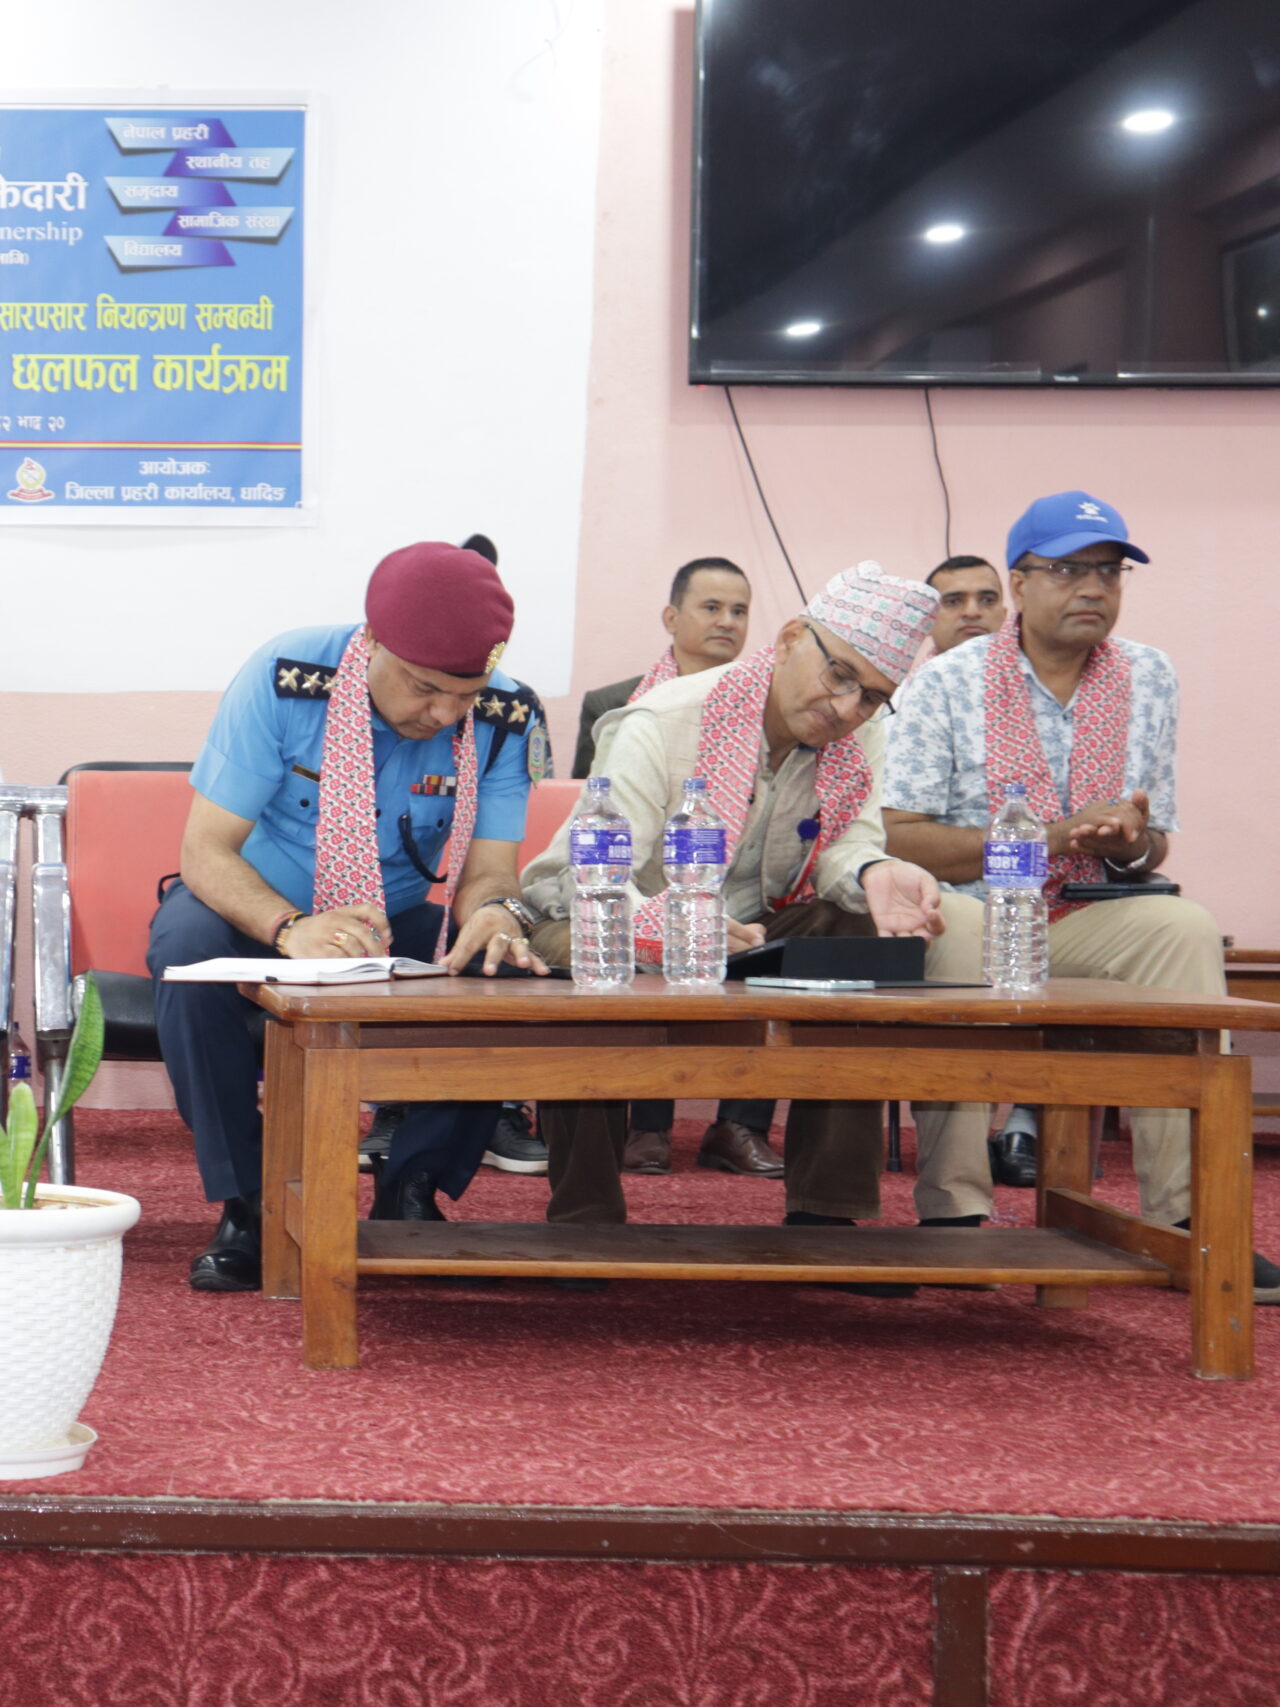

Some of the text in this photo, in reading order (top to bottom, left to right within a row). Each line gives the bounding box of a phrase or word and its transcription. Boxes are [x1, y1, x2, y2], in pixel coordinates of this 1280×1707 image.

[96, 294, 188, 332] नियन्त्रण
[194, 295, 274, 332] सम्बन्धी
[11, 353, 141, 394] छलफल
[152, 343, 290, 395] कार्यक्रम
[47, 416, 66, 432] २०
[65, 481, 115, 500] जिल्ला
[121, 482, 159, 502] प्रहरी
